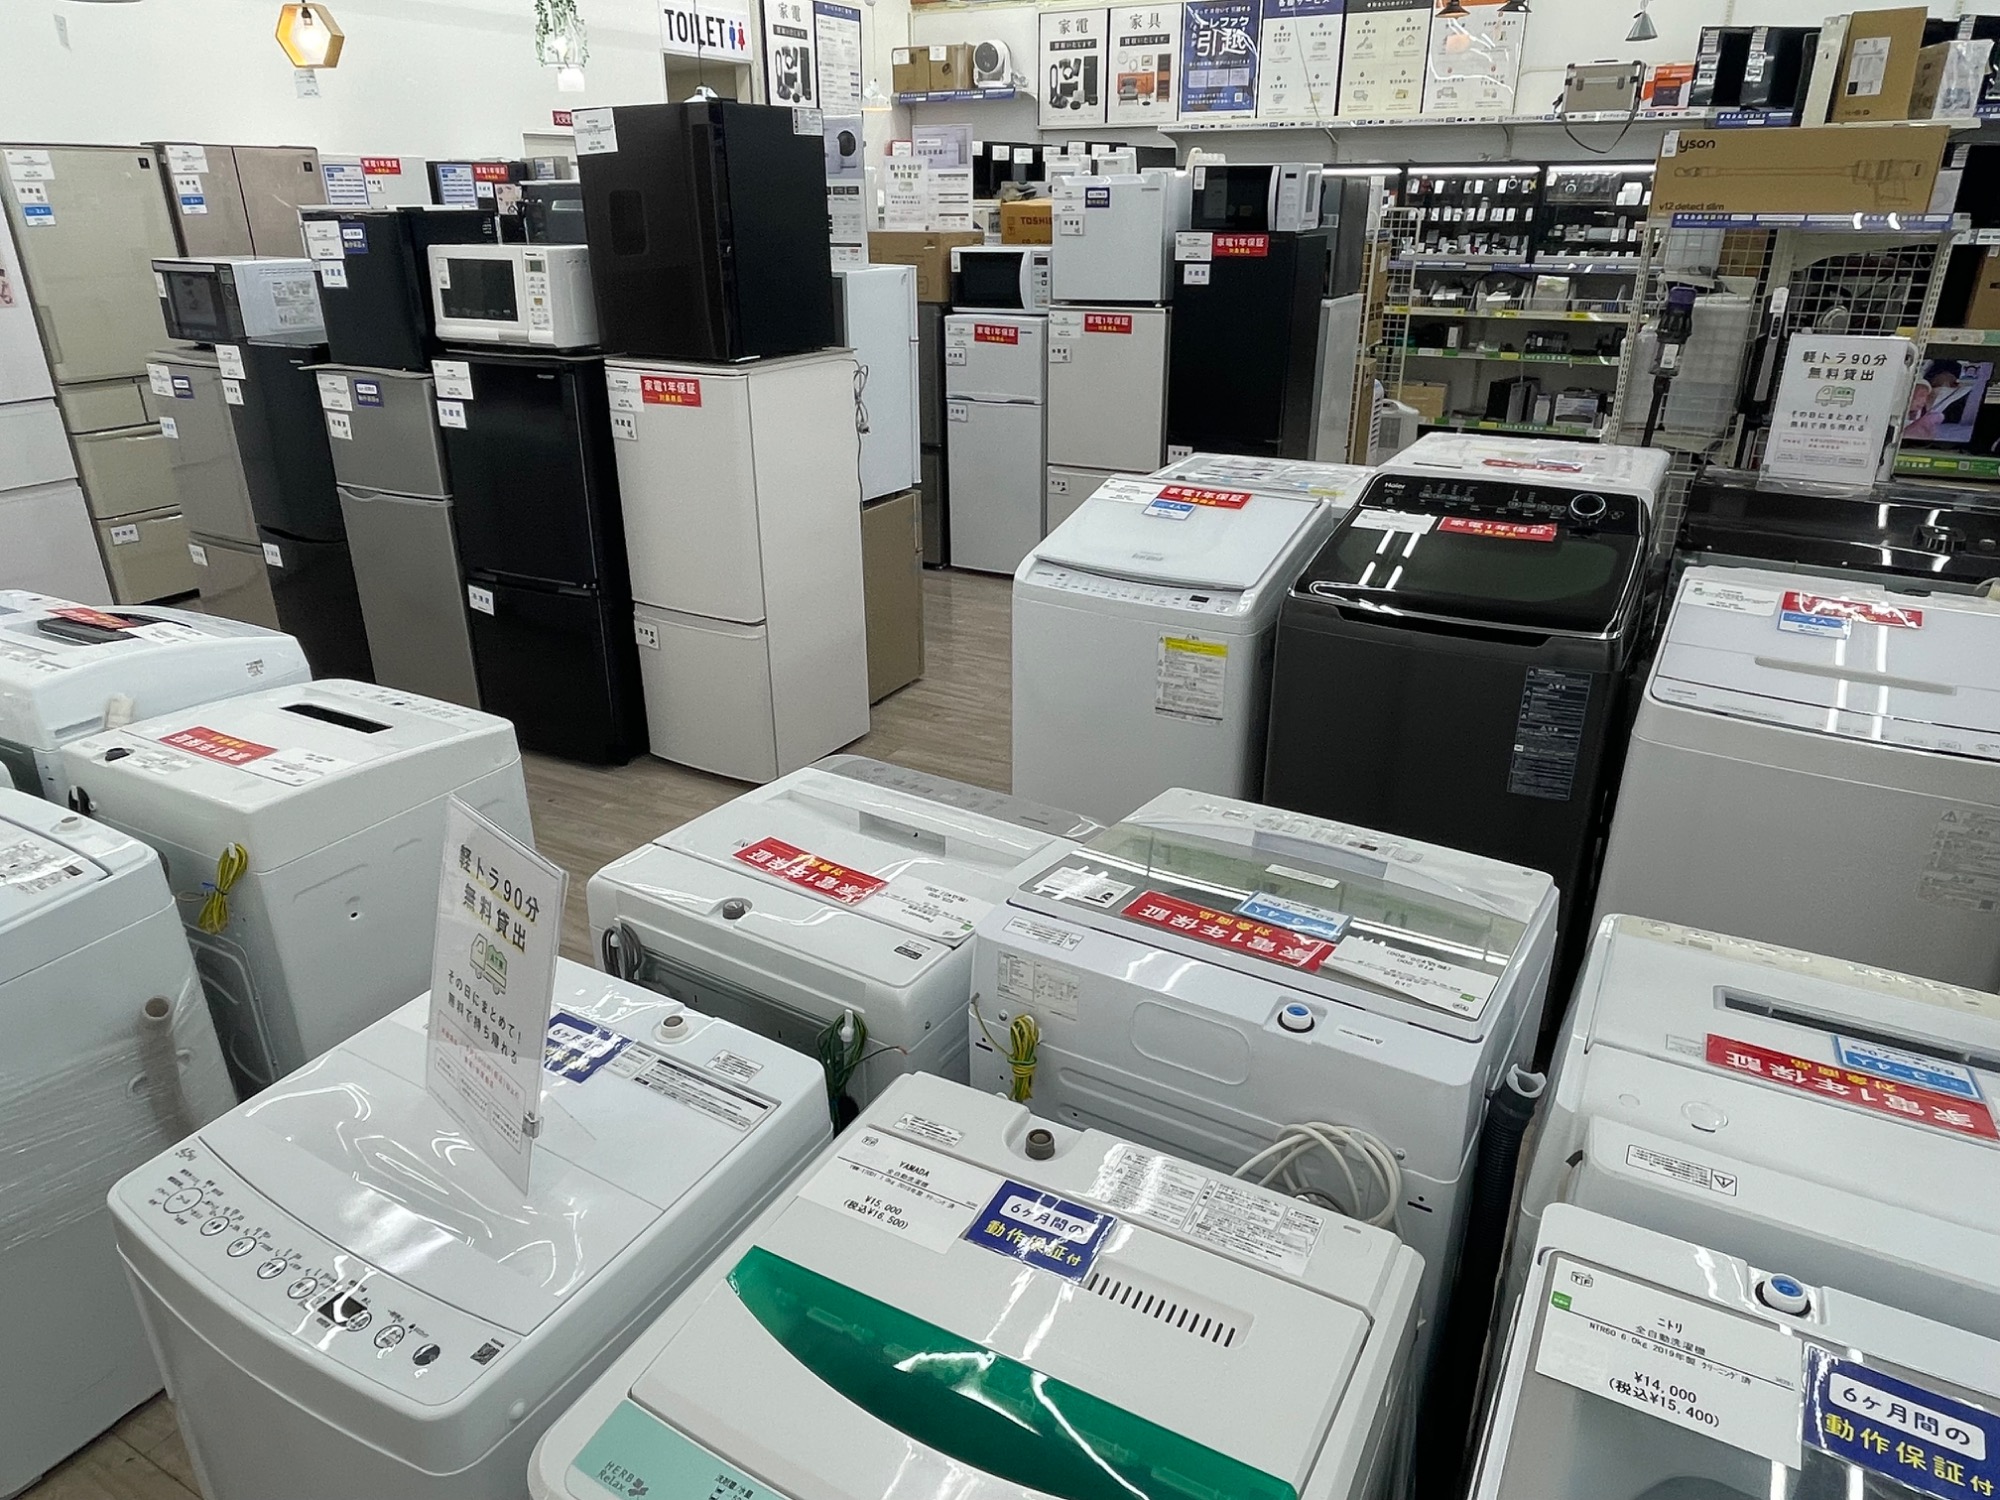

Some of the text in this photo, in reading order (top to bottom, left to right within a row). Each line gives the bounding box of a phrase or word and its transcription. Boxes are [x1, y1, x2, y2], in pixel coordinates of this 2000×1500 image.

[778, 2, 802, 23] 家電
[1130, 12, 1161, 30] 家具
[664, 8, 725, 49] TOILET
[1058, 17, 1088, 35] 家電
[1677, 137, 1716, 153] yson
[1674, 202, 1705, 211] detect
[1705, 202, 1725, 211] slim
[1216, 237, 1265, 248] 家電1年保証
[976, 326, 1016, 337] 家電1年保証
[1087, 315, 1129, 326] 家電1年保証
[1802, 350, 1888, 367] 軽トラ90分
[1808, 367, 1875, 381] 無料貸出
[643, 379, 697, 395] 家電1年保証
[1166, 486, 1246, 503] 家電1年保証
[1450, 519, 1553, 535] 家電1年保証
[460, 843, 540, 923] 軽トラ90分
[745, 848, 861, 899] 家電1年保証
[462, 882, 526, 952] 無料貸出
[1199, 910, 1273, 937] 対象商品
[1138, 904, 1312, 960] 家電1年保証
[448, 969, 522, 1044] その日にまとめて!
[448, 991, 518, 1065] 無料で持ち帰れる
[1790, 1058, 1897, 1093] 対象商品
[1725, 1050, 1975, 1129] 家電1年保証
[886, 1168, 929, 1188] 全自動洗濯機
[899, 1161, 930, 1178] YAMADA
[1010, 1203, 1085, 1235] 6ヶ月間の
[984, 1219, 1083, 1267] 動作保証付
[1657, 1317, 1683, 1334] ニトリ
[1635, 1325, 1706, 1357] 全自動洗濯機
[1652, 1344, 1697, 1367] 2019年製
[1843, 1387, 1971, 1446] 6ヶ月間の
[1824, 1412, 1995, 1497] 動作保証付
[598, 1470, 626, 1492] Relax
[604, 1461, 635, 1483] HERB
